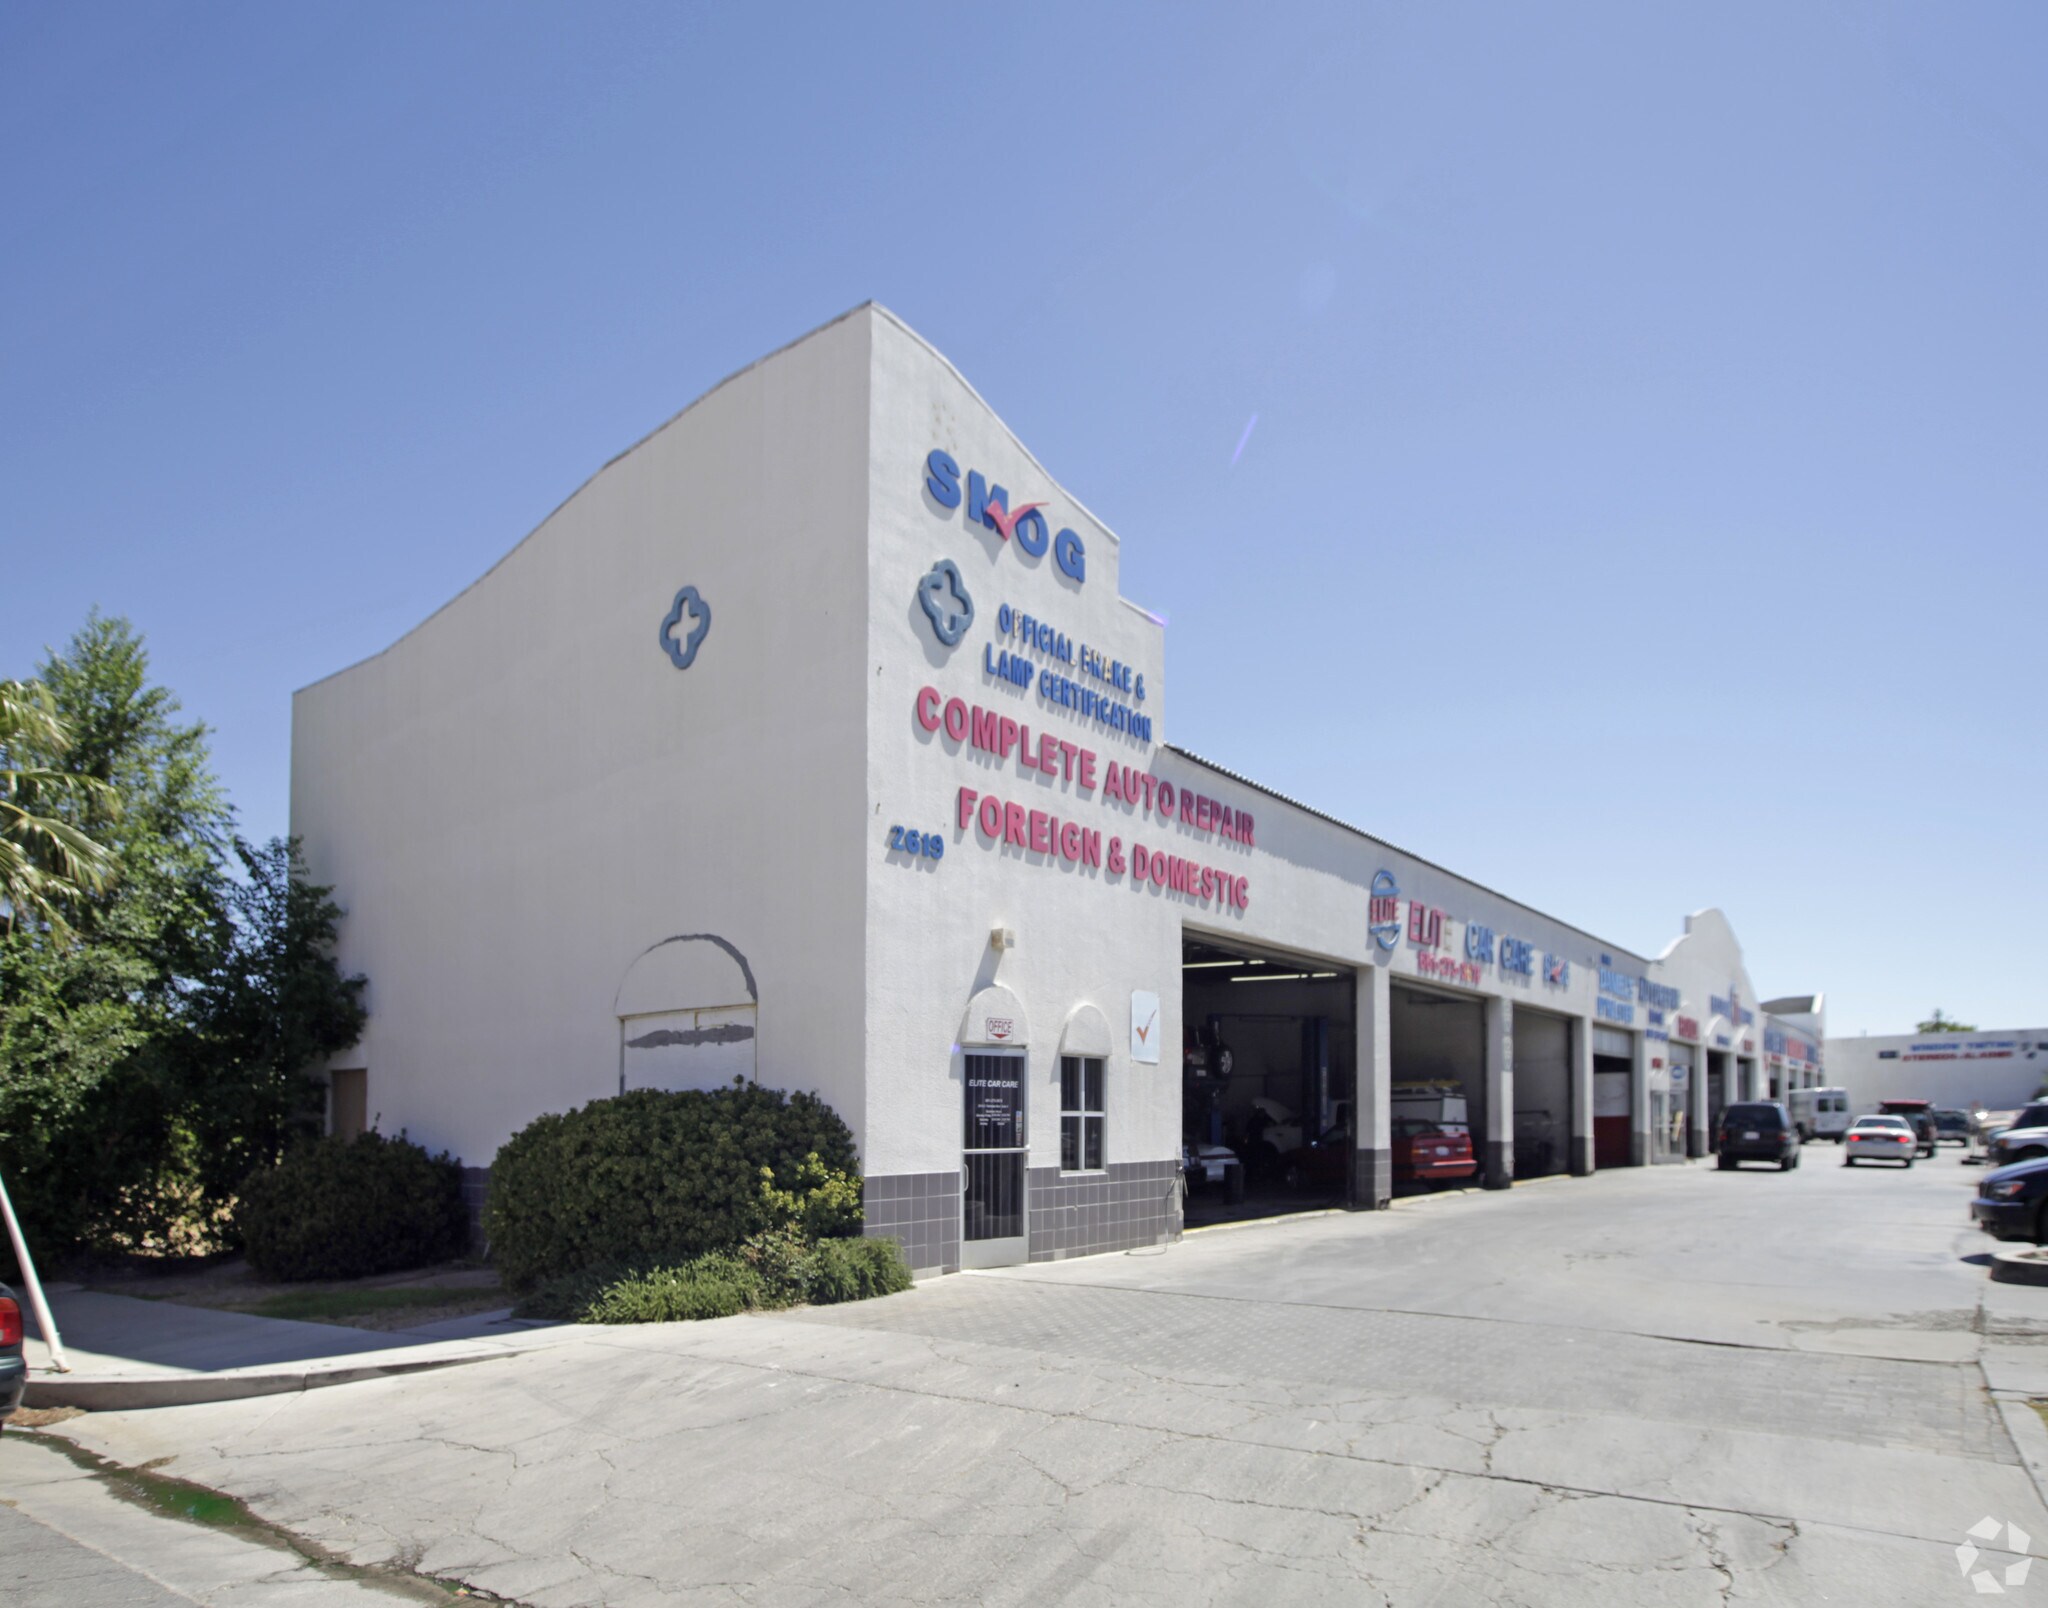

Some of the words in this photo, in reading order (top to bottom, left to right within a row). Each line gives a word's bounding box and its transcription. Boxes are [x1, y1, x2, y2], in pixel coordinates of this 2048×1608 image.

[926, 448, 1086, 584] SMOG
[998, 602, 1078, 667] OFFICIAL
[1081, 643, 1133, 694] BRAKE
[1136, 672, 1146, 701] &
[986, 642, 1034, 690] LAMP
[1040, 668, 1153, 742] CERTIFICATION
[917, 686, 1097, 791] COMPLETE
[1105, 760, 1176, 817] AUTO
[1180, 789, 1256, 848] REPAIR
[890, 825, 944, 860] 2619
[959, 786, 1101, 868] FOREIGN
[1108, 836, 1127, 875] &
[1134, 843, 1250, 910] DOMESTIC
[1370, 897, 1400, 923] ELITE
[1465, 920, 1496, 965] CAR
[1500, 933, 1536, 977] CARE
[989, 1020, 1012, 1033] OFFICE
[969, 1079, 987, 1087] ELITE
[987, 1080, 1001, 1088] CAR
[1001, 1080, 1019, 1088] CARE
